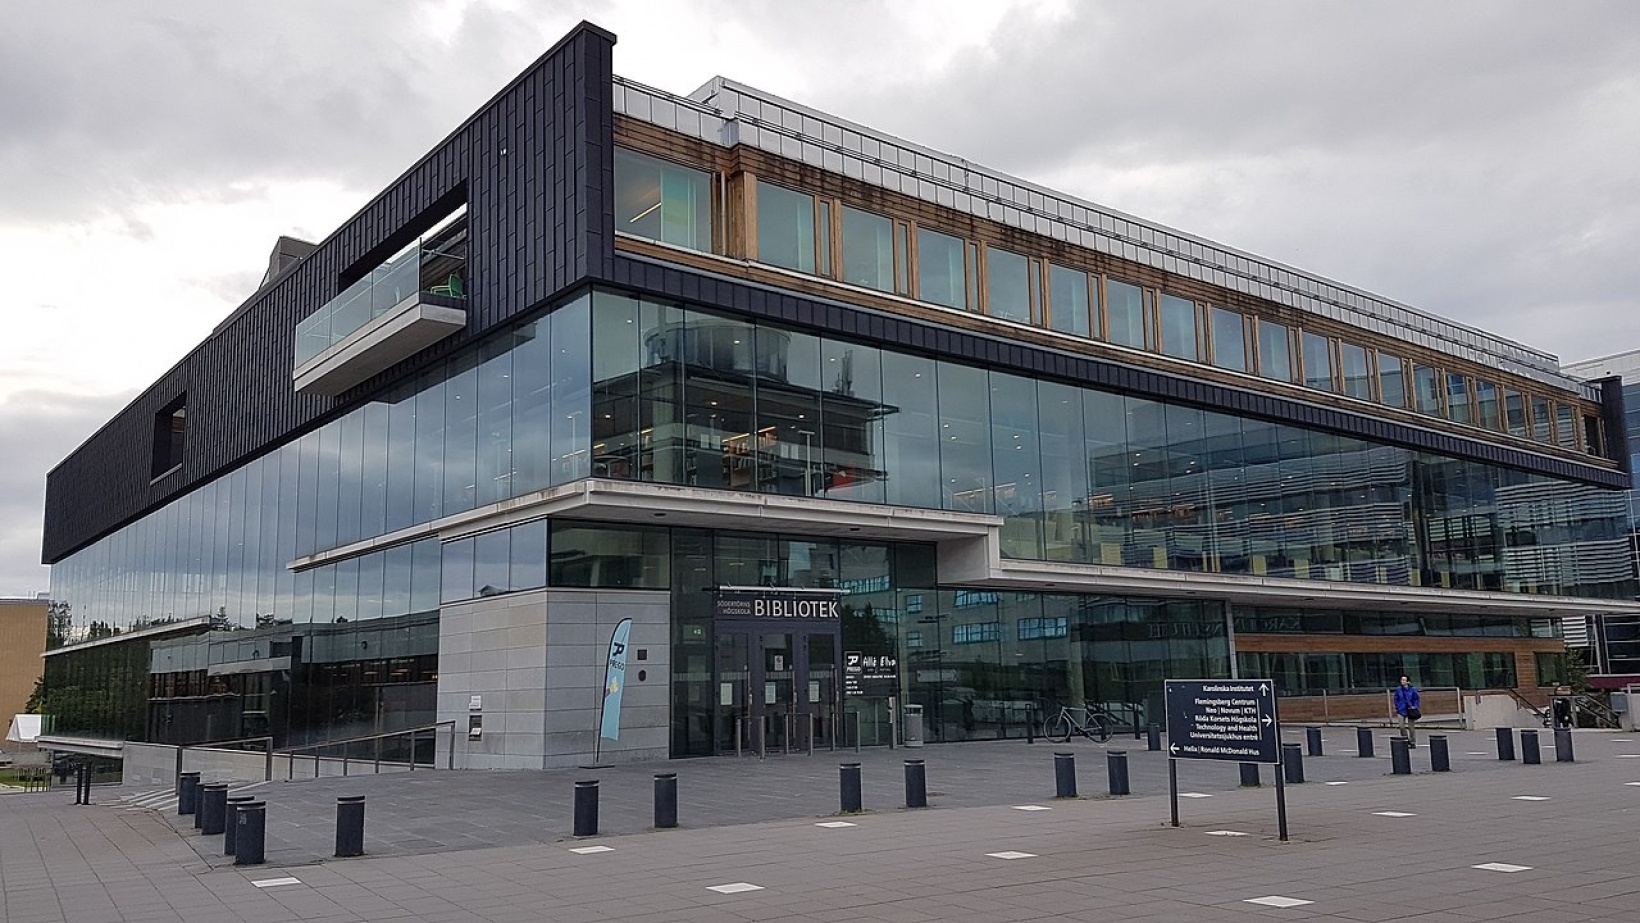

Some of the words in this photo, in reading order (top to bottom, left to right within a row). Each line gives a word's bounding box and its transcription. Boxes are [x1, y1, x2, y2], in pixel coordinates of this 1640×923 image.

[723, 607, 751, 615] HÖGSKOLA
[754, 599, 839, 618] BIBLIOTEK
[1194, 698, 1231, 706] Flemingsberg
[1196, 723, 1227, 732] Technology
[1239, 724, 1258, 732] Health
[1220, 747, 1248, 755] McDonald
